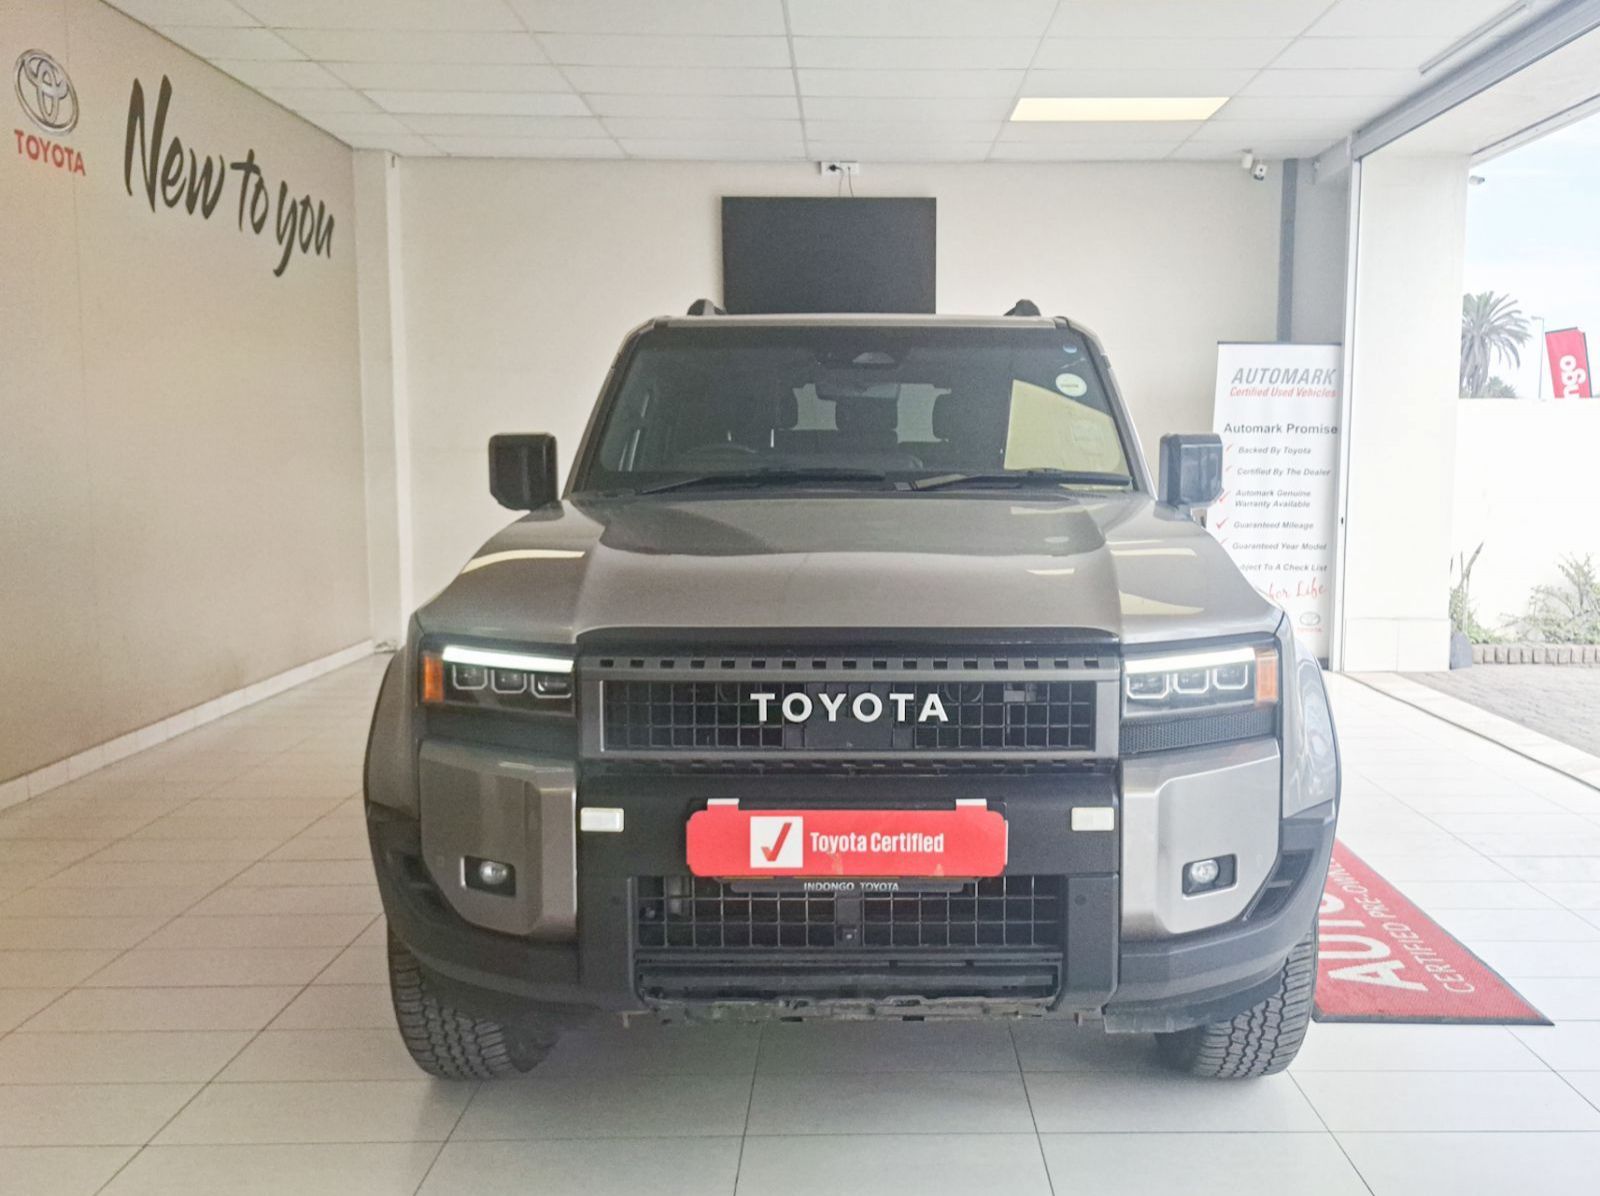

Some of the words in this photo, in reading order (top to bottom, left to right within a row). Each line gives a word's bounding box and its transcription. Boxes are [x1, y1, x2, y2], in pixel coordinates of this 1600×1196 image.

[14, 129, 86, 176] TOYOTA
[124, 74, 226, 220] New
[230, 148, 269, 235] to
[273, 180, 335, 278] you
[1230, 367, 1337, 385] AUTOMARK
[1230, 387, 1268, 397] Certified
[1270, 387, 1294, 397] Used
[1296, 387, 1337, 398] Vehicles
[1223, 423, 1282, 434] Automark
[1286, 424, 1338, 434] Promise
[1238, 446, 1268, 454] Backed
[1270, 446, 1281, 456] By
[1283, 446, 1311, 456] Toyota
[1237, 467, 1271, 476] Certified
[1273, 468, 1283, 477] By
[1286, 468, 1301, 476] The
[1303, 468, 1331, 476] Dealer
[1235, 489, 1274, 497] Automark
[1277, 489, 1311, 497] Genuine
[1235, 500, 1271, 509] Warranty
[1273, 500, 1310, 508] Available
[1233, 521, 1280, 529] Guaranteed
[1282, 521, 1314, 530] Mileage
[1232, 542, 1279, 550] Guaranteed
[1281, 542, 1299, 550] Year
[1301, 542, 1327, 551] Model
[1264, 563, 1273, 571] To
[1275, 563, 1281, 571] A
[1283, 563, 1309, 571] Check
[1311, 563, 1328, 572] List
[750, 692, 949, 722] TOYOTA
[810, 832, 868, 854] Toyota
[870, 832, 944, 853] Certified
[804, 882, 855, 891] INDONGO
[861, 882, 899, 891] TOYOTA
[1382, 921, 1475, 993] CERTIFIED
